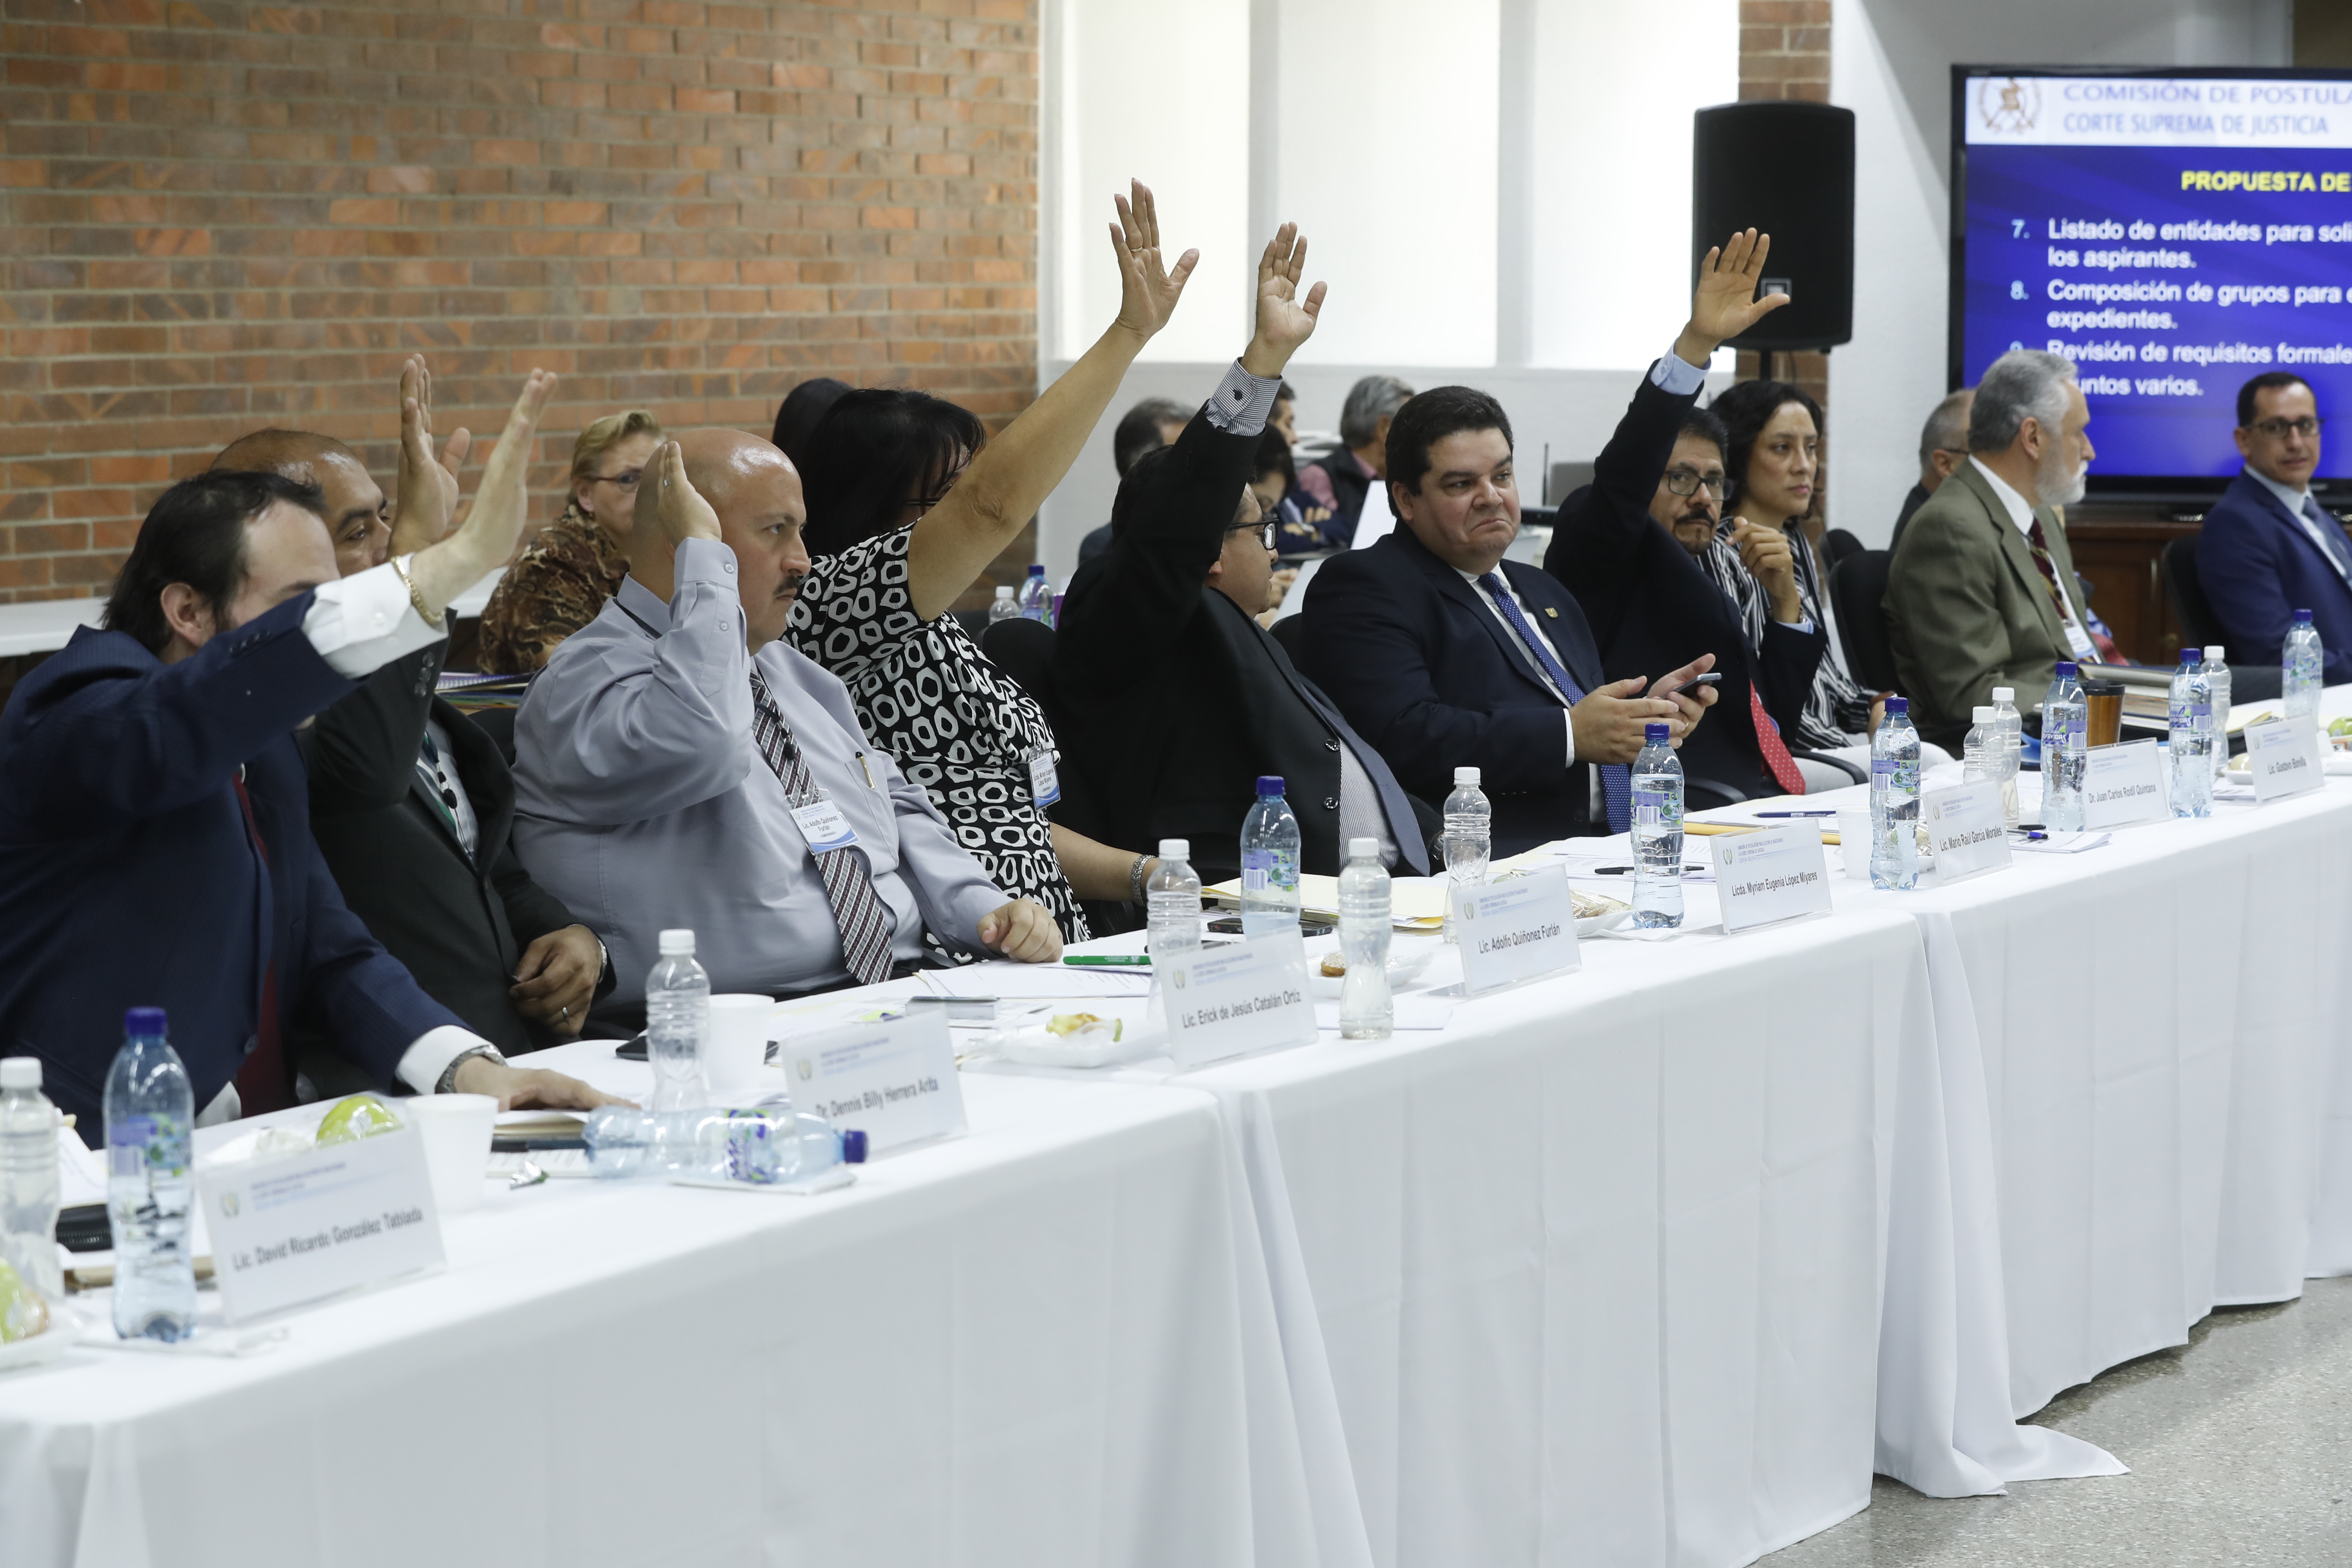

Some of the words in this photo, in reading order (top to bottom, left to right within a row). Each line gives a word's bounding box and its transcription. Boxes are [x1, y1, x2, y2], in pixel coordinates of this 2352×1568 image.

[2064, 79, 2200, 102] COMISIÓN
[2209, 86, 2241, 103] DE
[2064, 112, 2124, 133] CORTE
[2131, 113, 2214, 134] SUPREMA
[2221, 114, 2245, 135] DE
[2249, 114, 2329, 137] JUSTICIA
[2180, 170, 2317, 192] PROPUESTA
[2321, 172, 2351, 193] DE
[2011, 218, 2030, 239] 7.
[2049, 217, 2125, 240] Listado
[2128, 218, 2156, 240] de
[2160, 220, 2262, 242] entidades
[2266, 224, 2315, 246] para
[2048, 245, 2080, 267] los
[2083, 246, 2197, 272] aspirantes.
[2010, 280, 2029, 300] 8.
[2047, 279, 2182, 305] Composición
[2186, 281, 2214, 302] de
[2217, 285, 2291, 307] grupos
[2294, 286, 2343, 307] para
[2046, 307, 2179, 332] expedientes.
[2047, 340, 2136, 361] Revisión
[2140, 341, 2168, 362] de
[2172, 341, 2273, 367] requisitos
[2135, 374, 2204, 396] varios.
[2096, 791, 2107, 802] Juan
[2107, 789, 2123, 800] Carlos
[2136, 784, 2156, 796] Quintana
[1939, 839, 1949, 851] Lic.
[1948, 835, 1961, 849] Mario
[1960, 832, 1972, 846] Raúl
[1972, 829, 1985, 843] García
[1985, 825, 2002, 839] Morales
[1731, 885, 1747, 897] Licda.
[1747, 881, 1765, 896] Myriam
[1765, 876, 1785, 891] Eugenia
[1784, 874, 1800, 888] López
[1799, 871, 1818, 885] Miyares
[1479, 940, 1491, 954] Lic.
[1491, 934, 1512, 951] Adolfo
[1512, 929, 1542, 946] Quiñonez
[1541, 923, 1561, 939] Furlán
[1182, 1013, 1197, 1029] Lic.
[1197, 1007, 1218, 1025] Erick
[1220, 1004, 1229, 1020] de
[1231, 999, 1253, 1018] Jesús
[1254, 994, 1282, 1012] Catalán
[830, 1096, 863, 1117] Dennis
[862, 1090, 884, 1110] Billy
[883, 1085, 918, 1102] Herrera
[232, 1252, 253, 1271] Lic.
[255, 1242, 288, 1265] David
[289, 1230, 330, 1254] Ricardo
